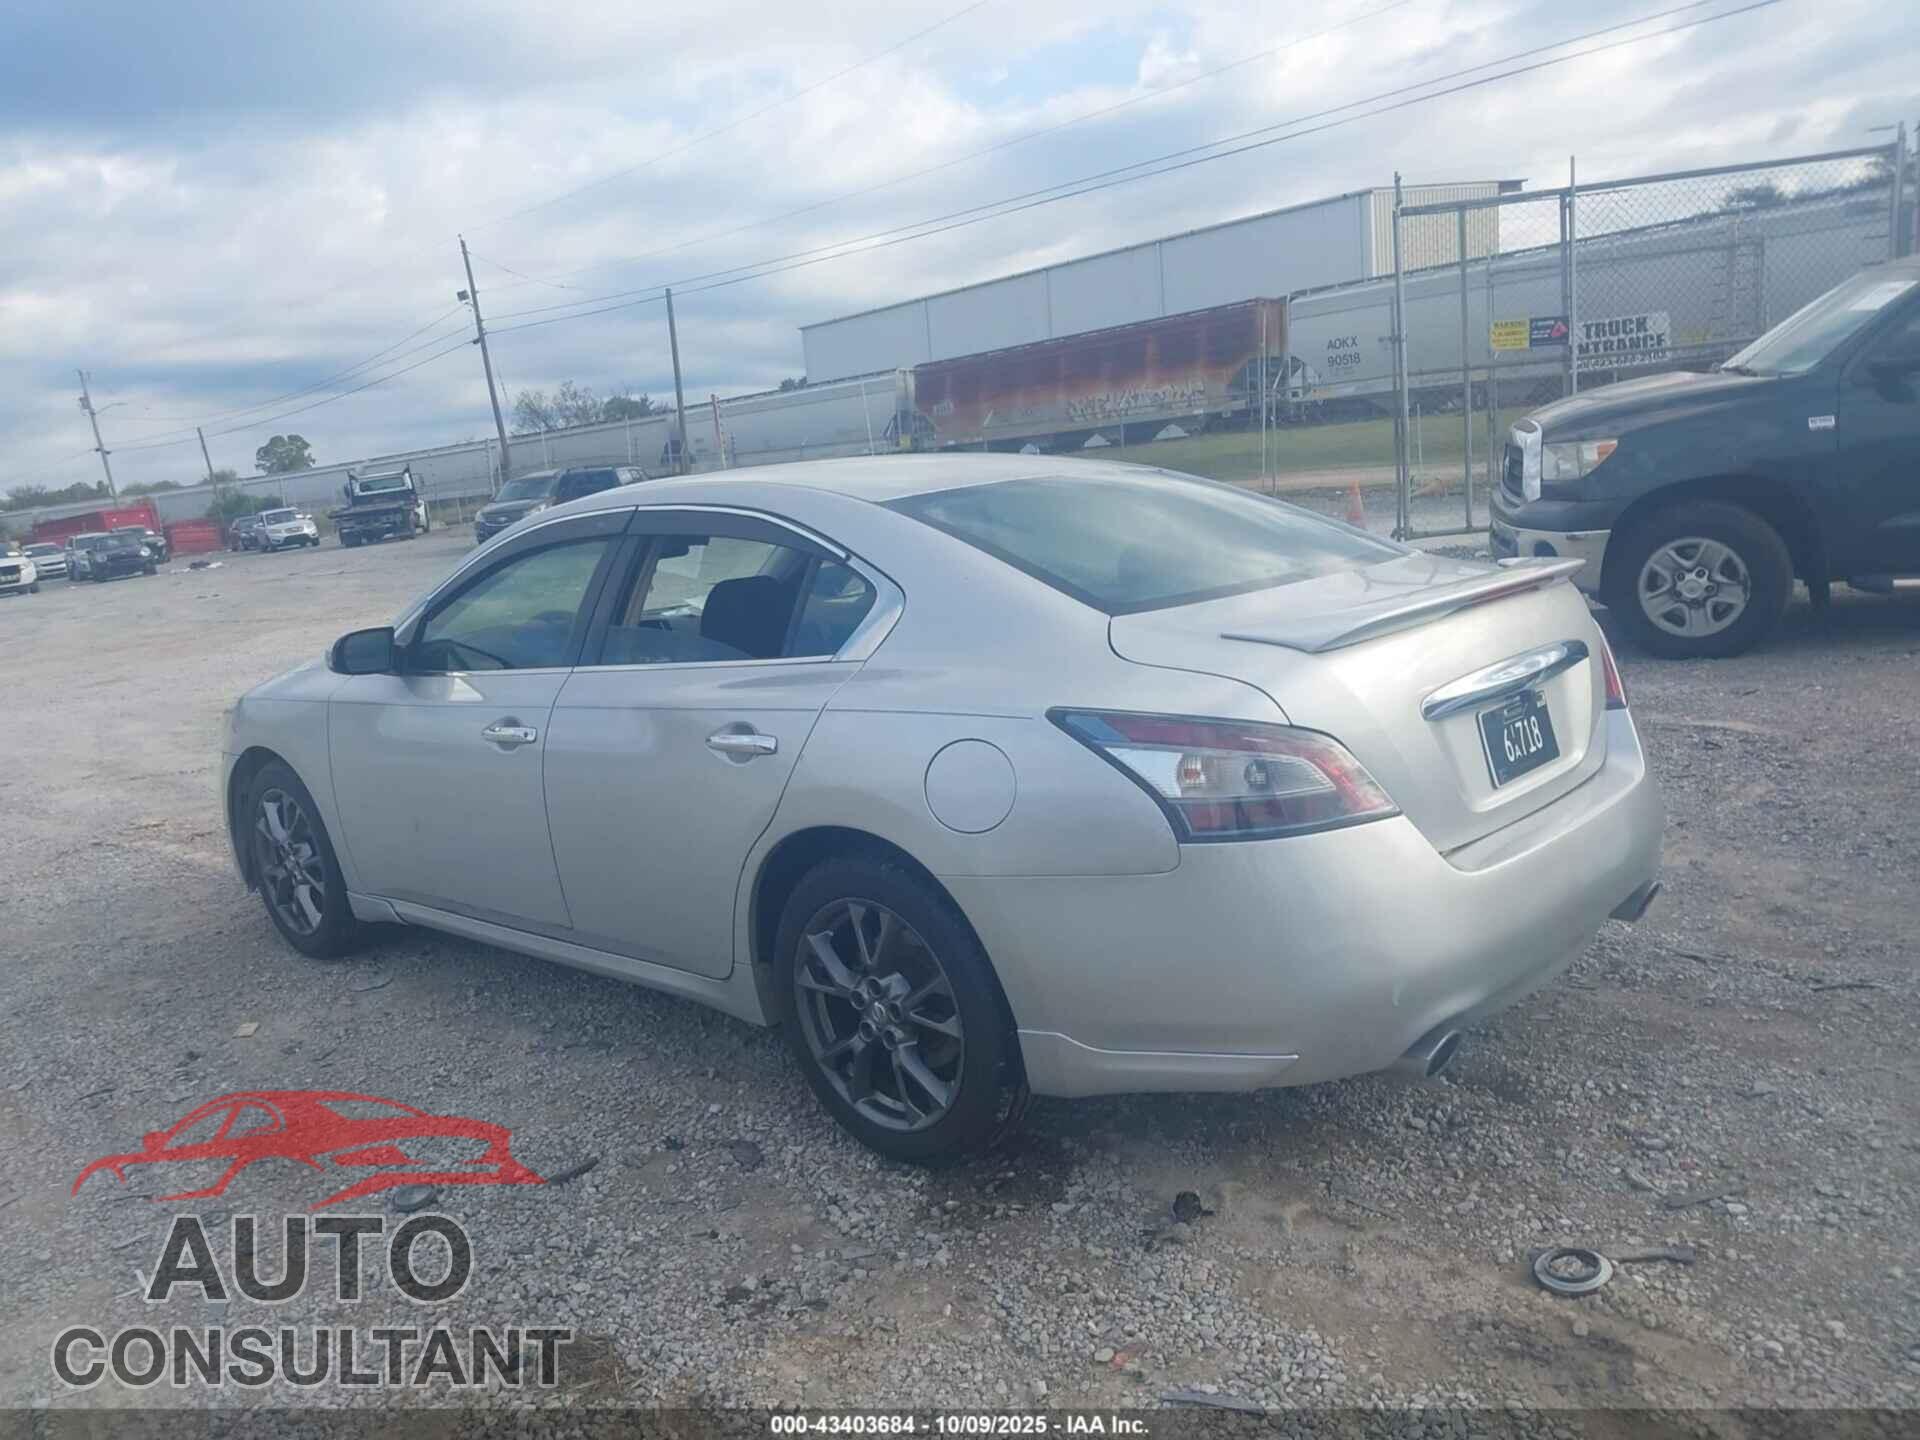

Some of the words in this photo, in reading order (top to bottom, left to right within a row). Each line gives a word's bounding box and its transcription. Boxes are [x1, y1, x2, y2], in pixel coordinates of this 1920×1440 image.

[1582, 316, 1649, 339] TRUCK
[1569, 333, 1666, 355] NTRANCE
[1327, 352, 1361, 367] 90518
